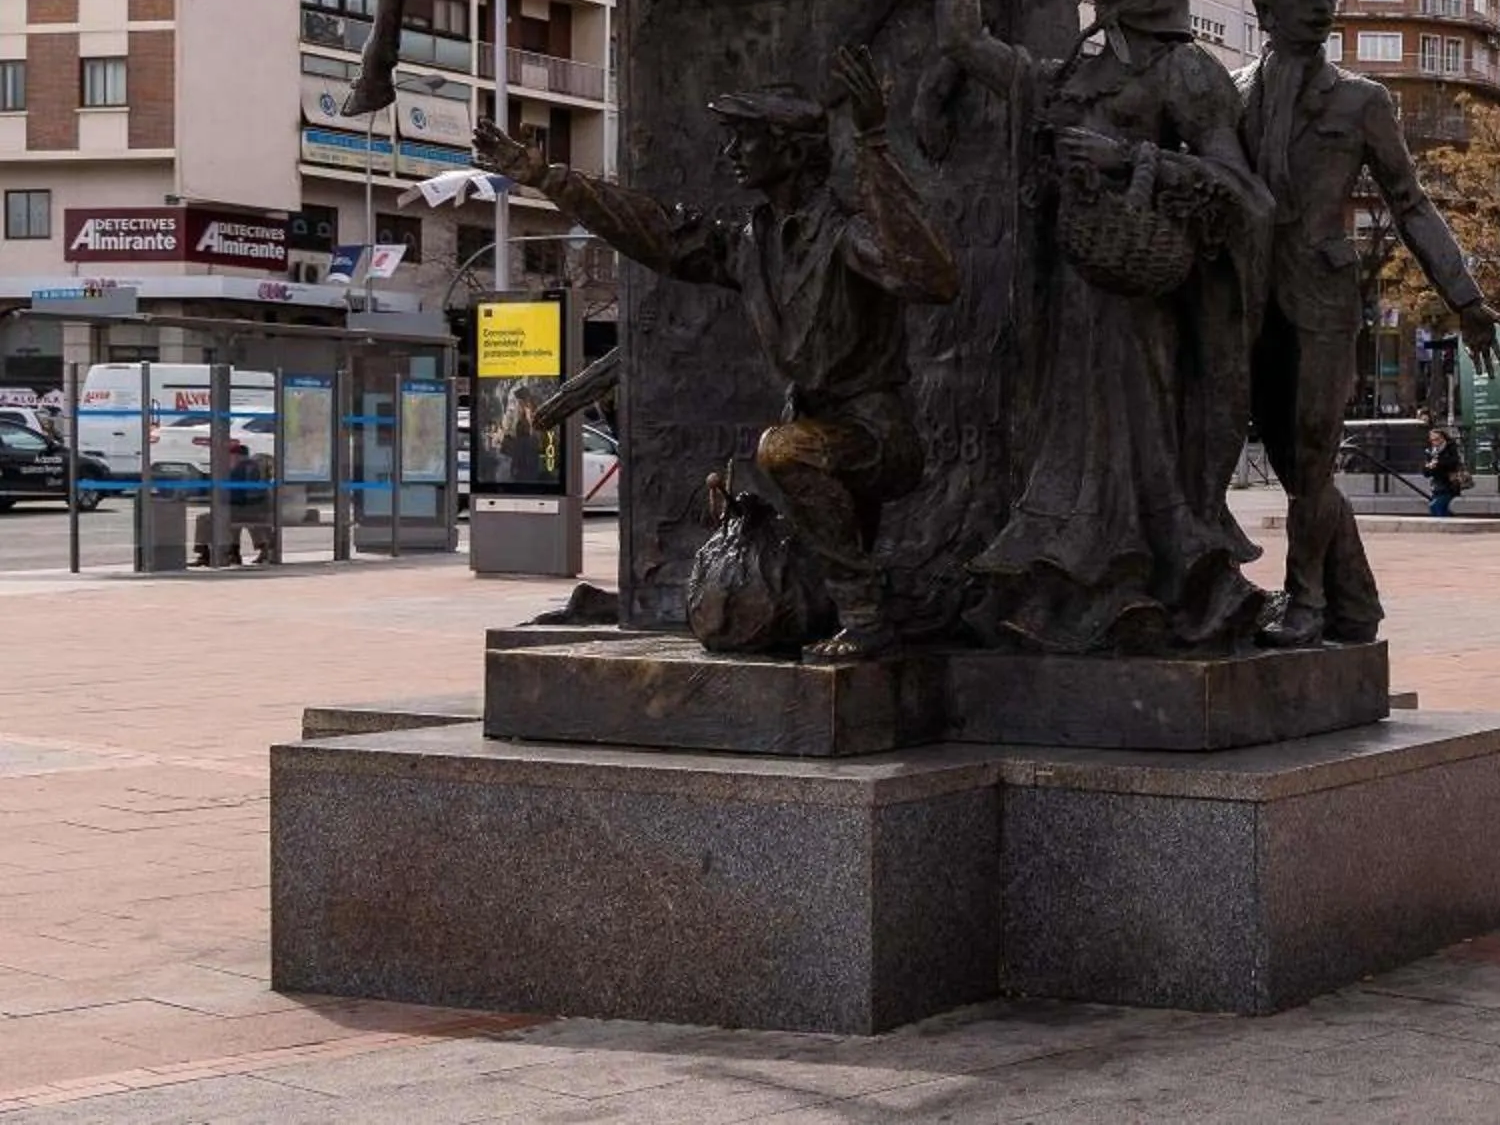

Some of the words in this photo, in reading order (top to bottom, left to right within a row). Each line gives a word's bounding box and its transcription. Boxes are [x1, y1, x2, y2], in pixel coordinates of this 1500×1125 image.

[95, 218, 176, 231] DETECTIVES
[218, 222, 286, 241] DETECTIVES
[70, 219, 177, 251] Almirante
[196, 221, 286, 259] Almirante
[175, 391, 211, 411] ALVE
